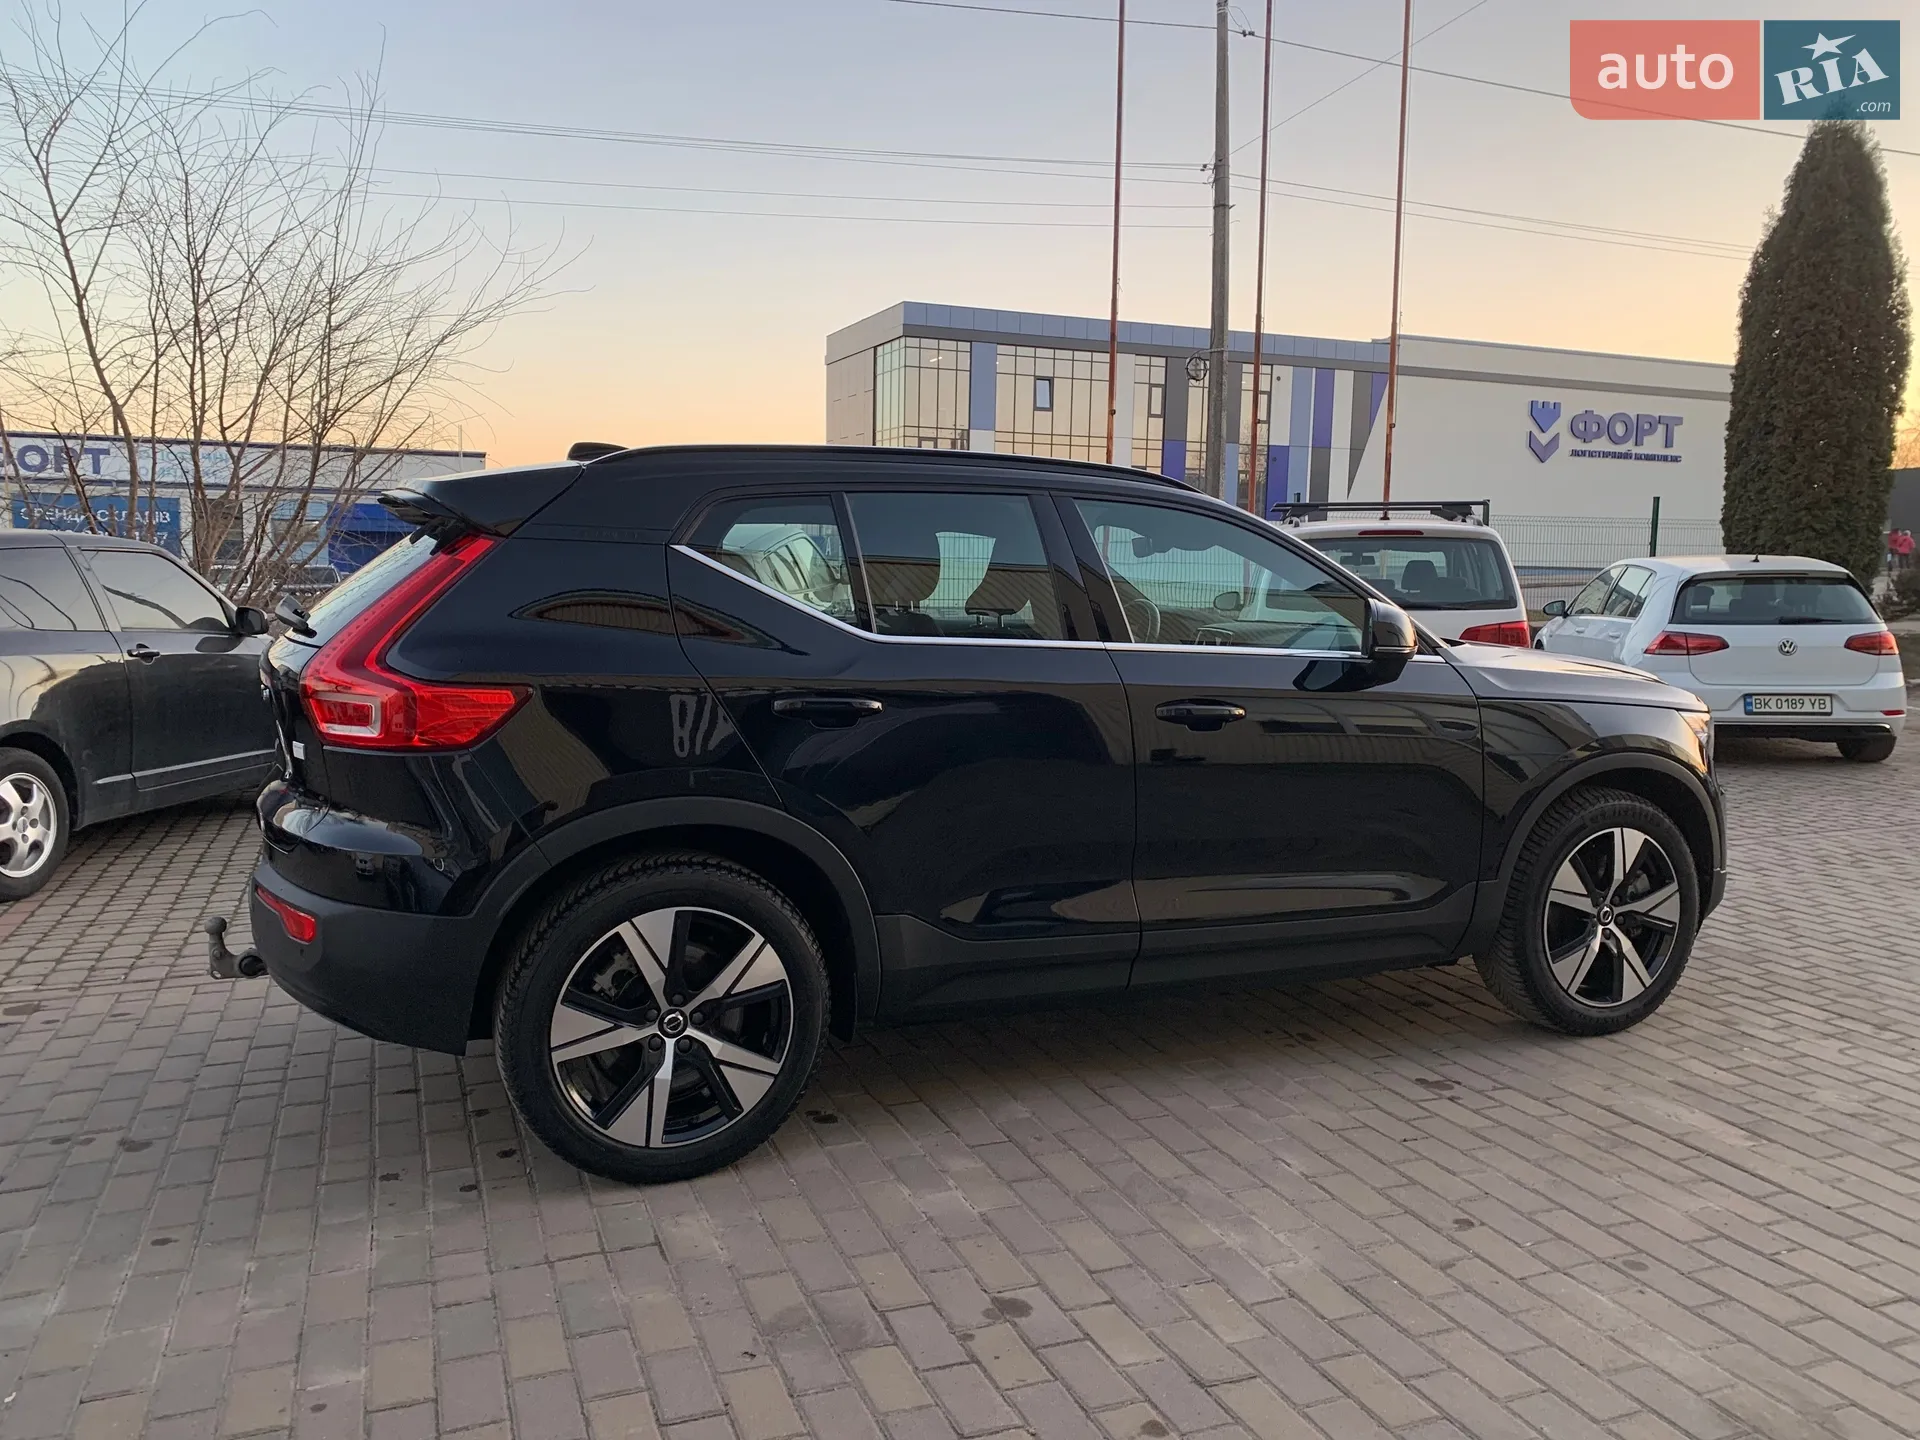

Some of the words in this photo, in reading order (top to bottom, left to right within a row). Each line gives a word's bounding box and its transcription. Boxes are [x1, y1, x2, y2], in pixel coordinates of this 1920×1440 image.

[1570, 410, 1683, 449] ФОРТ
[0, 445, 110, 474] ОРТ
[1754, 698, 1773, 710] BK
[1775, 698, 1804, 710] 0189
[1808, 698, 1827, 710] YB
